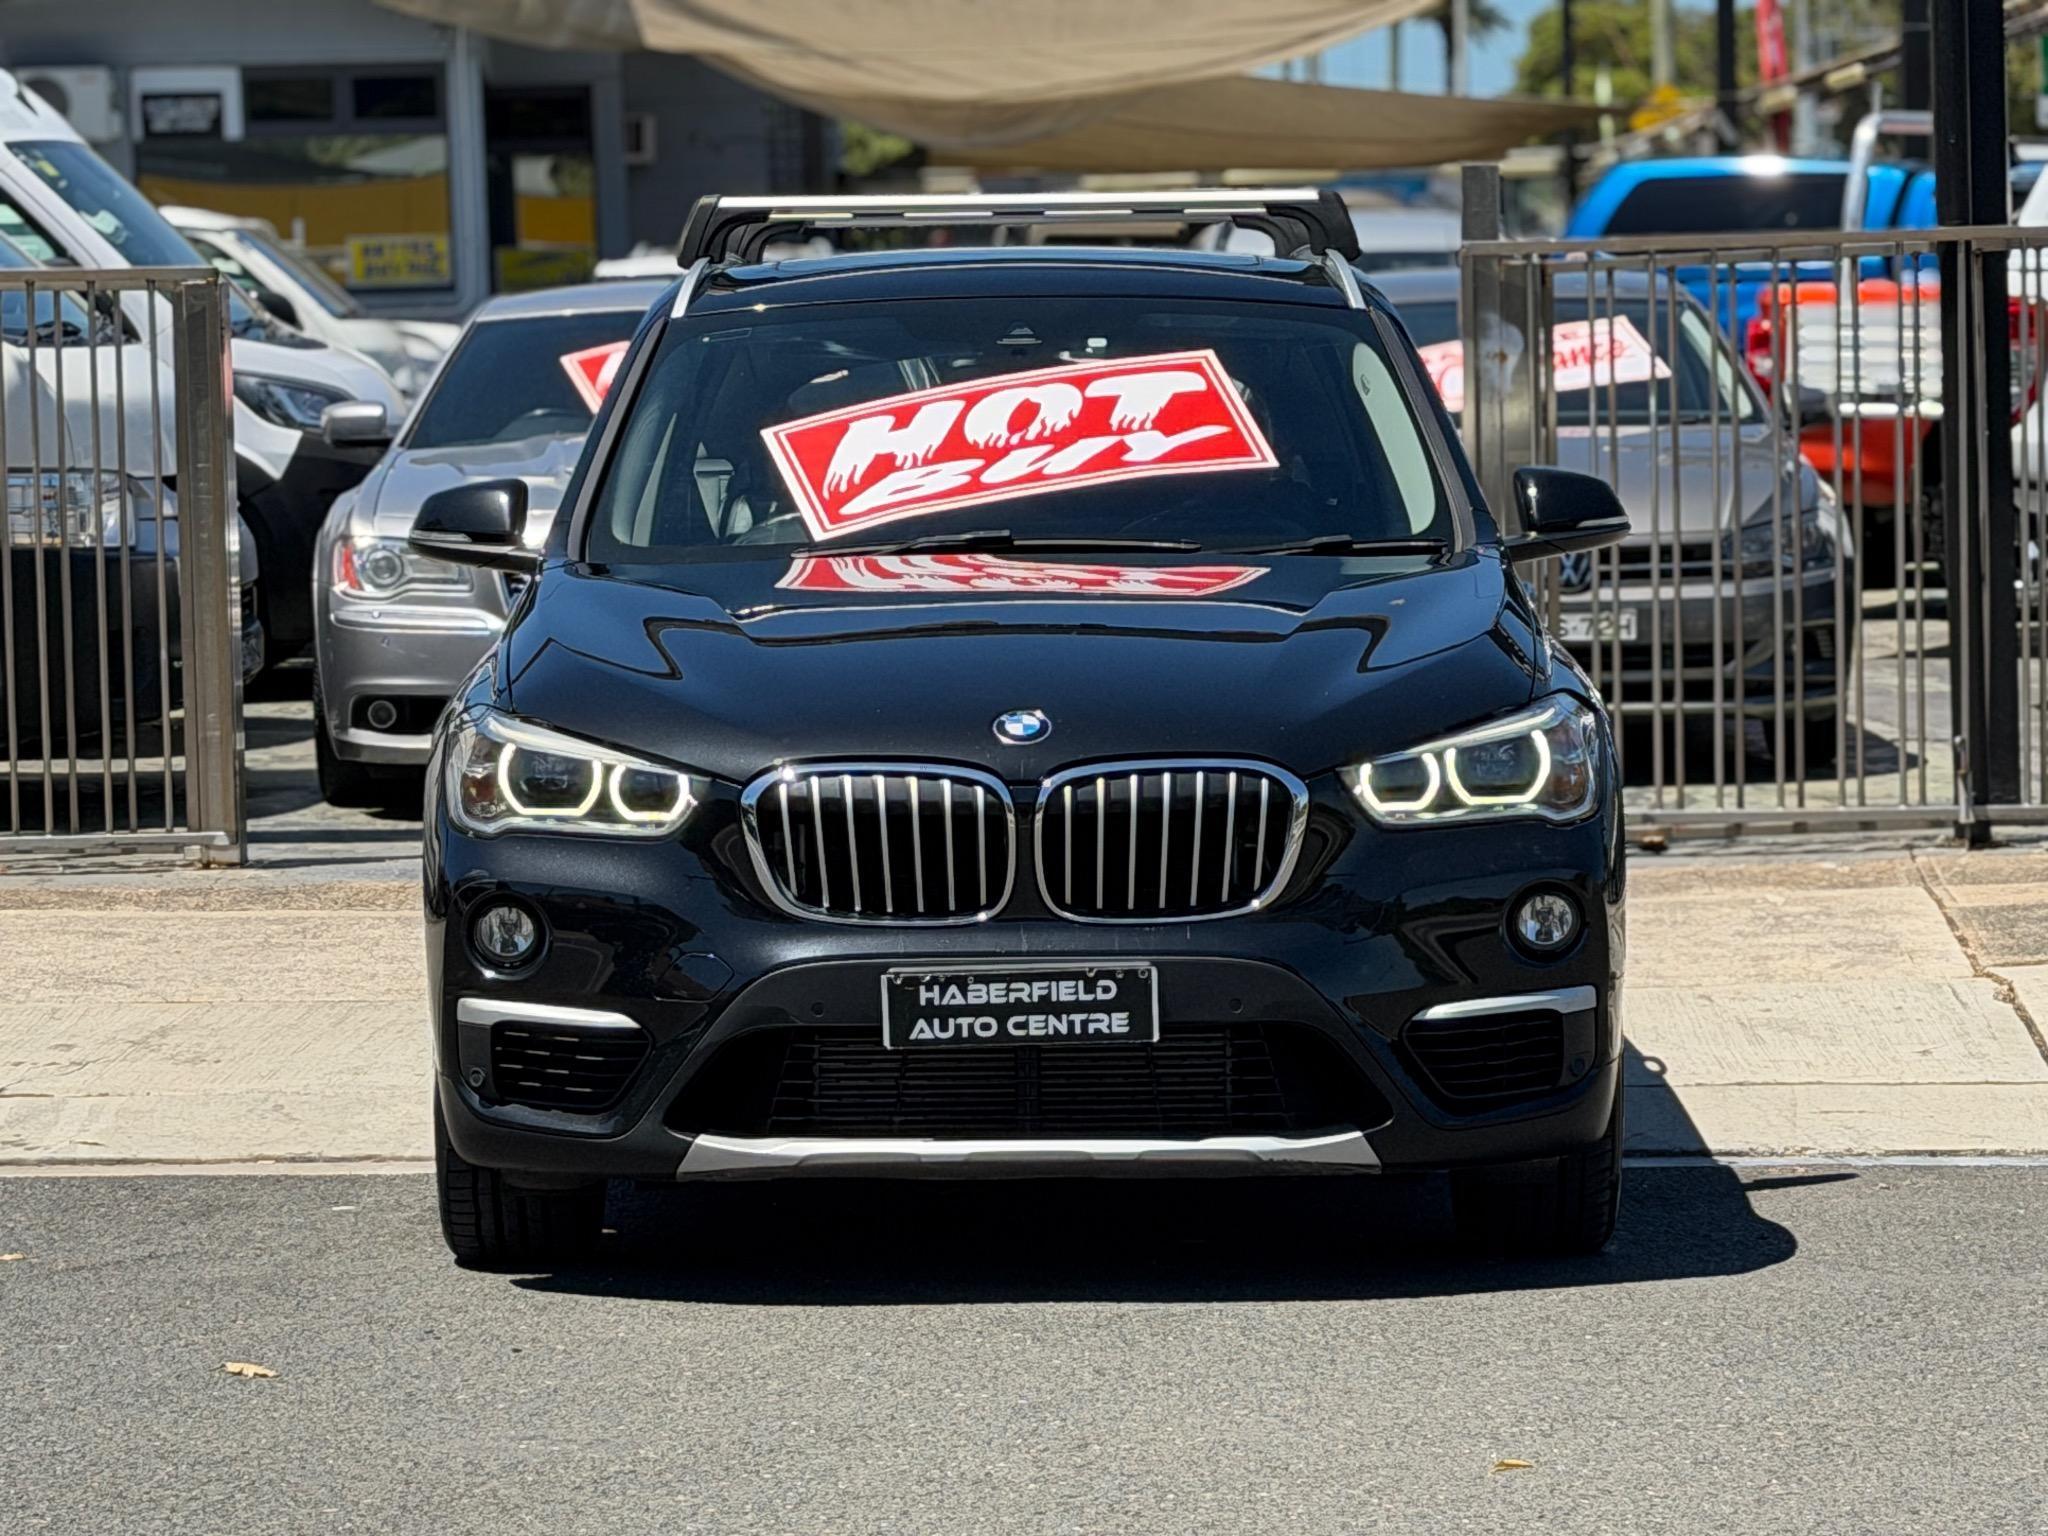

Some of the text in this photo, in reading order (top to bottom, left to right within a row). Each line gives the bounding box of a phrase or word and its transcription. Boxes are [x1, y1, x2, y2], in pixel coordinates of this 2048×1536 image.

[823, 371, 1208, 500] HOT
[839, 426, 1232, 516] BUY
[918, 979, 1118, 1006] HABERFIELD
[908, 1012, 1130, 1040] AUTO CENTRE
